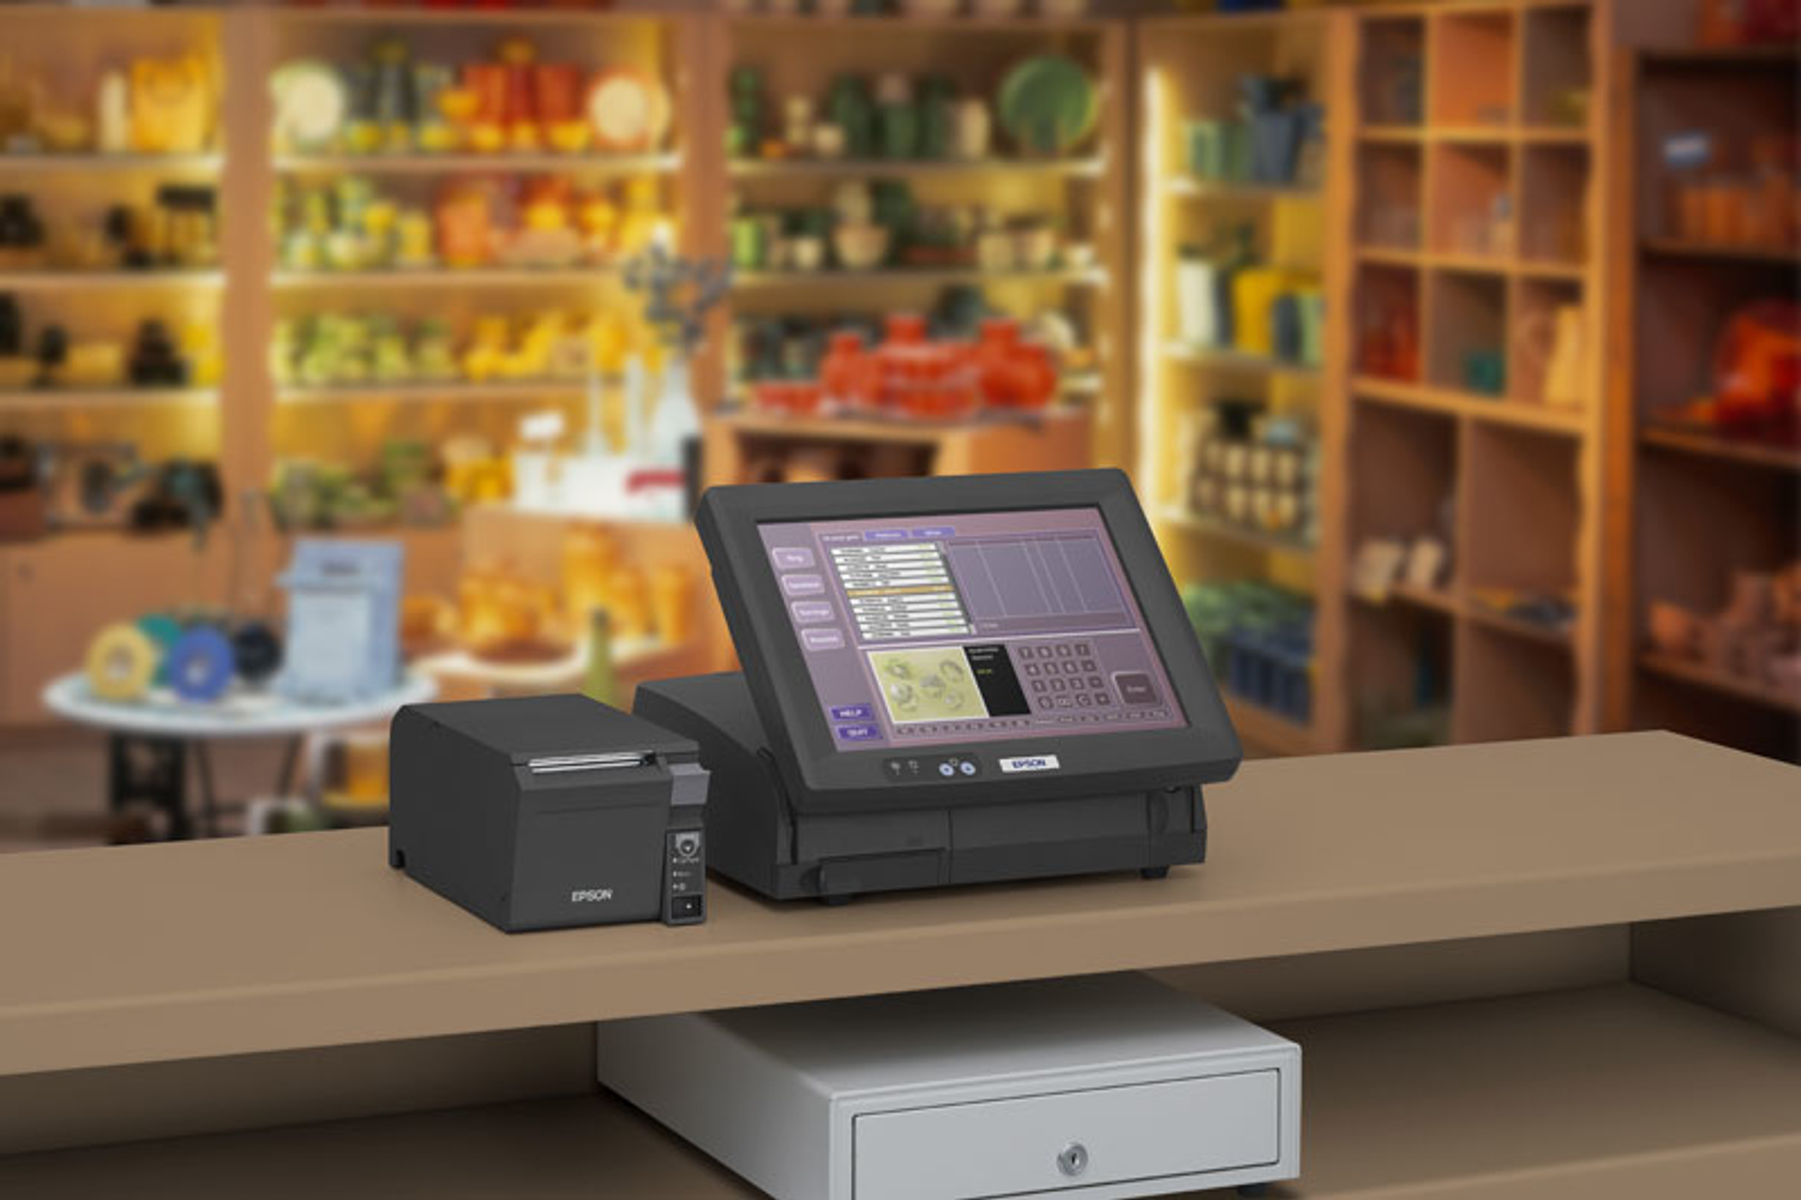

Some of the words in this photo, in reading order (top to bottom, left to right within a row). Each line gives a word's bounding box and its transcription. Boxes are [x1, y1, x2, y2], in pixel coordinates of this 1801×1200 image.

[839, 708, 862, 718] HELP
[1011, 759, 1046, 769] EPSON
[571, 889, 613, 902] EPSON
